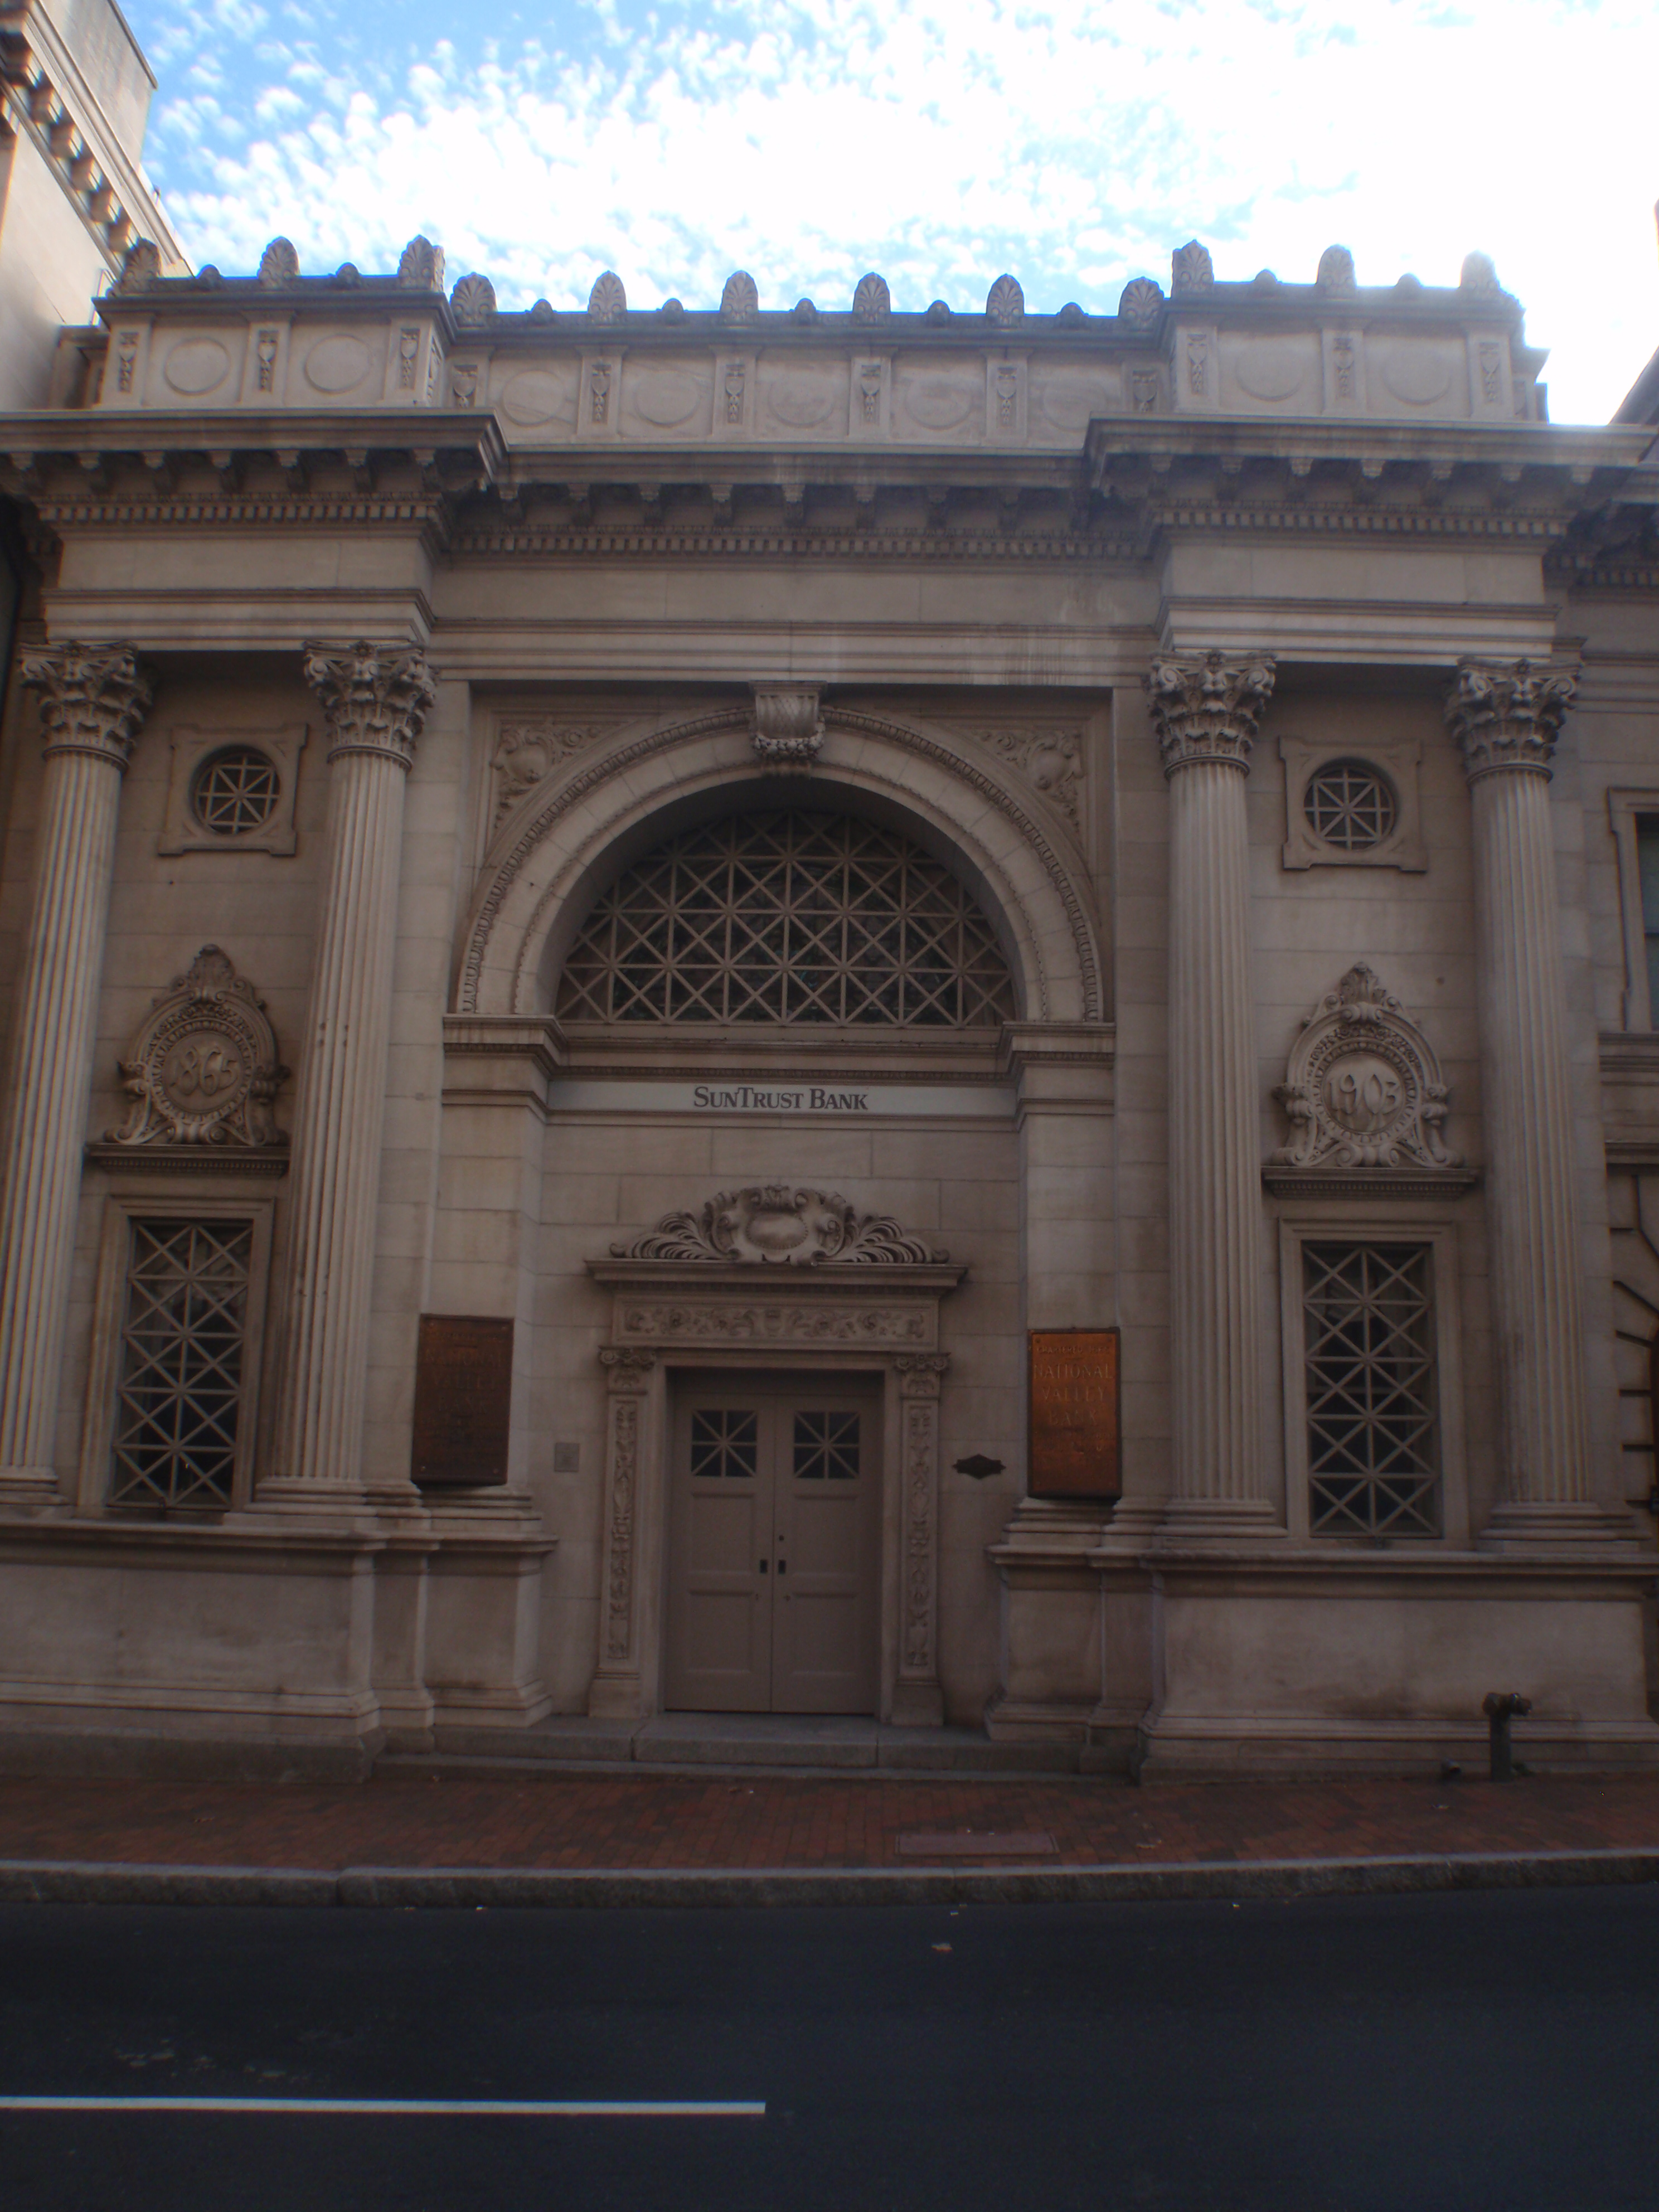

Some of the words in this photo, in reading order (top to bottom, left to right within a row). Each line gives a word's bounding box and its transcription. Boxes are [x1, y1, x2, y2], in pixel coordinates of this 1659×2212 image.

[169, 1045, 239, 1096] 1865
[809, 1088, 868, 1111] BANK
[1328, 1073, 1402, 1115] 1903
[1034, 1363, 1114, 1379] NATIONAL
[1041, 1386, 1108, 1402] VALLEY
[1048, 1410, 1098, 1426] BANK
